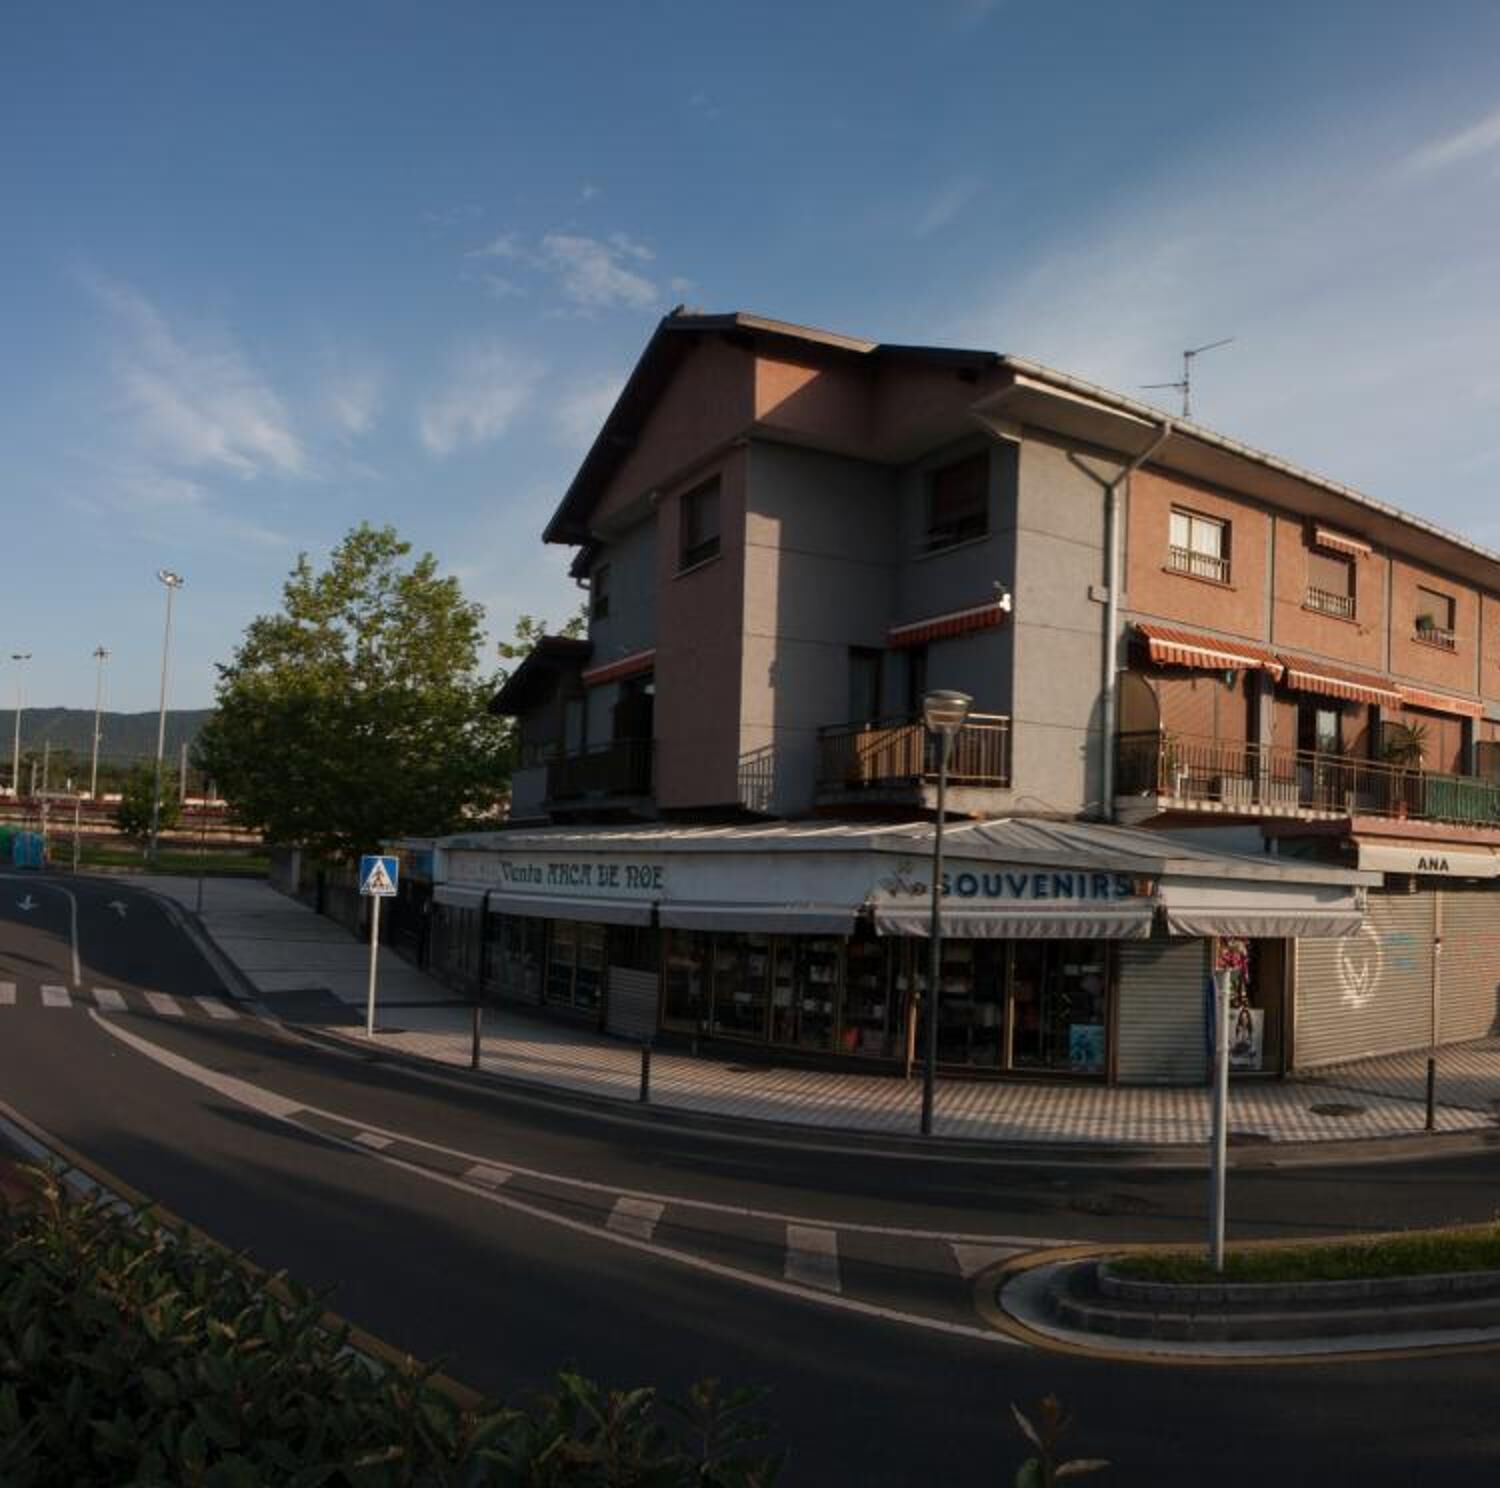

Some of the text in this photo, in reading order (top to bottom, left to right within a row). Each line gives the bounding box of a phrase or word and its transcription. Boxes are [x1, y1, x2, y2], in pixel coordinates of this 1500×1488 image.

[502, 861, 543, 884] Venta
[597, 864, 620, 888] DE
[1417, 856, 1449, 872] ANA
[941, 873, 1133, 898] SOUVENIRS
